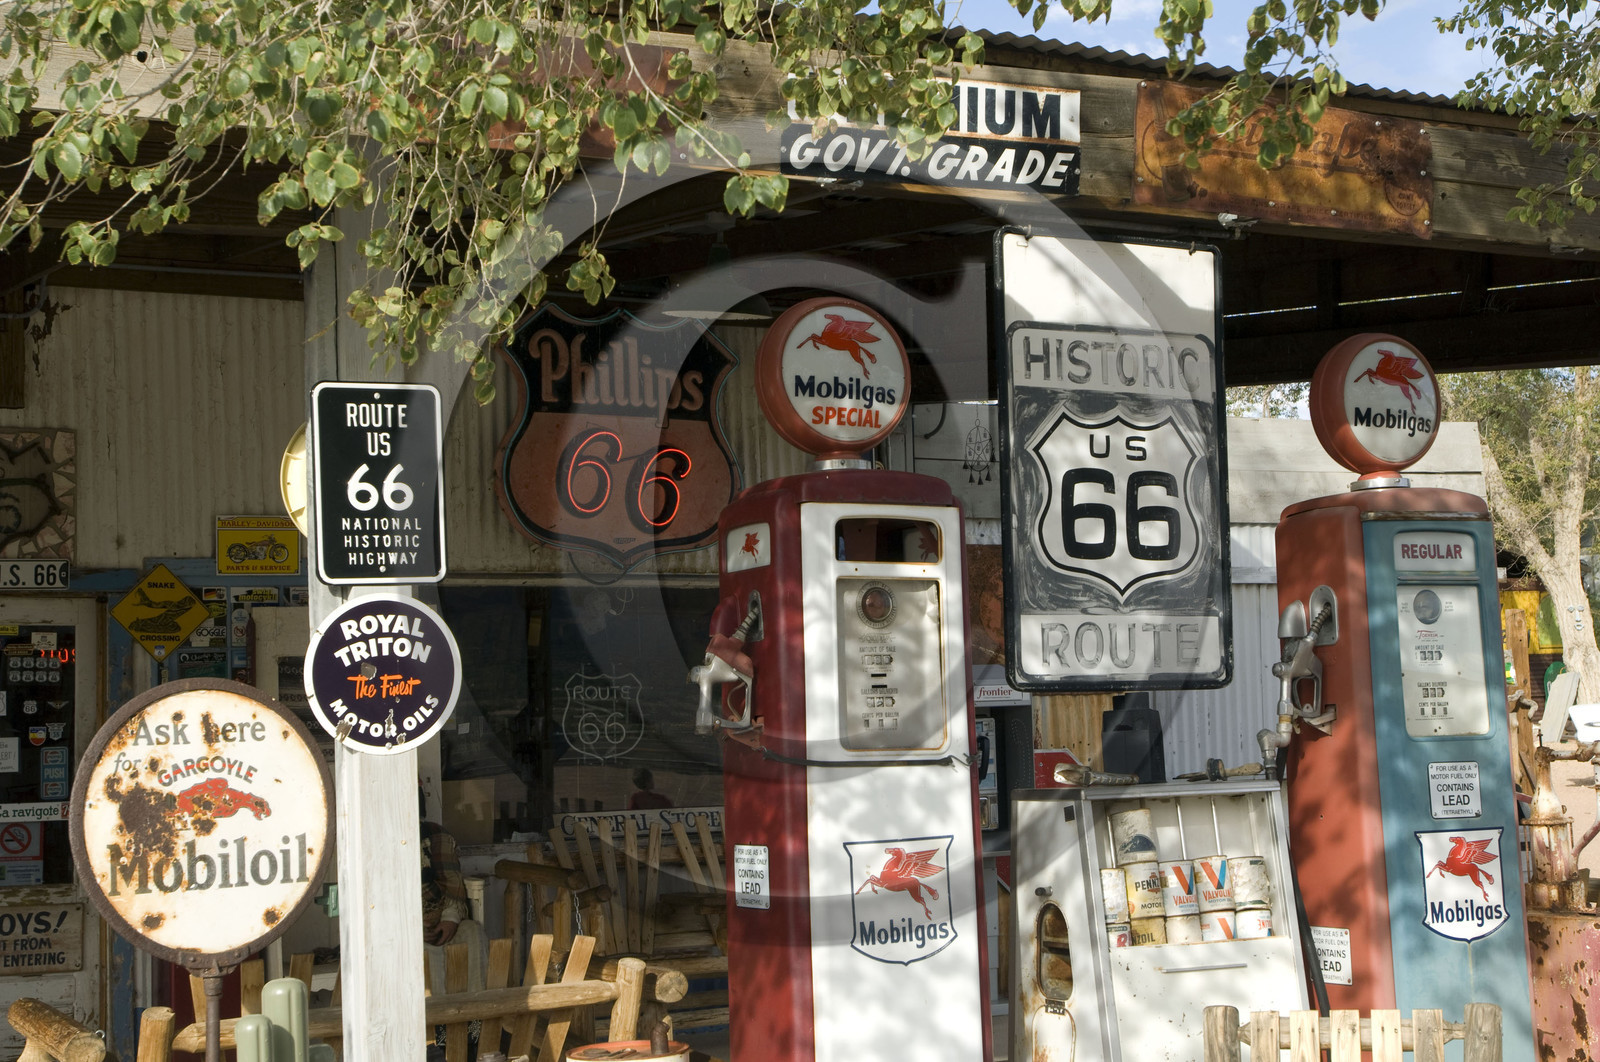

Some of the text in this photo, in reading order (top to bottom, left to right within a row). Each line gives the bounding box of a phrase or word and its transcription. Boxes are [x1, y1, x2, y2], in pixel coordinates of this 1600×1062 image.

[927, 143, 1076, 188] GRADE
[1023, 335, 1200, 393] HISTORIC
[528, 328, 704, 429] Phillips
[794, 375, 896, 409] Mobilgas
[345, 402, 408, 429] ROUTE
[811, 405, 882, 429] SPECIAL
[1353, 407, 1432, 437] Mobilgas
[366, 431, 391, 457] US
[347, 463, 414, 512] 66
[555, 427, 692, 535] 66
[341, 517, 422, 531] NATIONAL
[1060, 467, 1181, 561] 66
[344, 534, 420, 549] HISTORIC
[1401, 543, 1463, 560] REGULAR
[348, 552, 418, 566] HIGHWAY
[34, 564, 57, 587] 66
[140, 634, 181, 643] CROSSING
[339, 614, 425, 642] ROYAL
[333, 637, 432, 668] TRITON
[1040, 621, 1200, 669] ROUTE
[347, 674, 377, 699] The
[572, 685, 632, 700] ROUTE
[977, 686, 1013, 699] frontier
[329, 693, 440, 739] MOTOR OILS
[578, 711, 626, 745] 66
[132, 717, 191, 746] Ask
[44, 767, 64, 779] PUSH
[114, 752, 142, 775] for
[157, 755, 258, 787] GARGOYLE
[1436, 783, 1474, 792] CONTAINS
[1442, 794, 1470, 806] LEAD
[12, 805, 59, 820] ravigote
[106, 832, 310, 897] Mobiloil
[738, 868, 765, 880] CONTAINS
[741, 881, 761, 895] LEAD
[1430, 898, 1503, 927] Mobilgas
[13, 938, 52, 951] FROM
[859, 917, 949, 949] Mobilgas
[4, 952, 66, 968] ENTERING
[1315, 948, 1346, 959] ONTAINS
